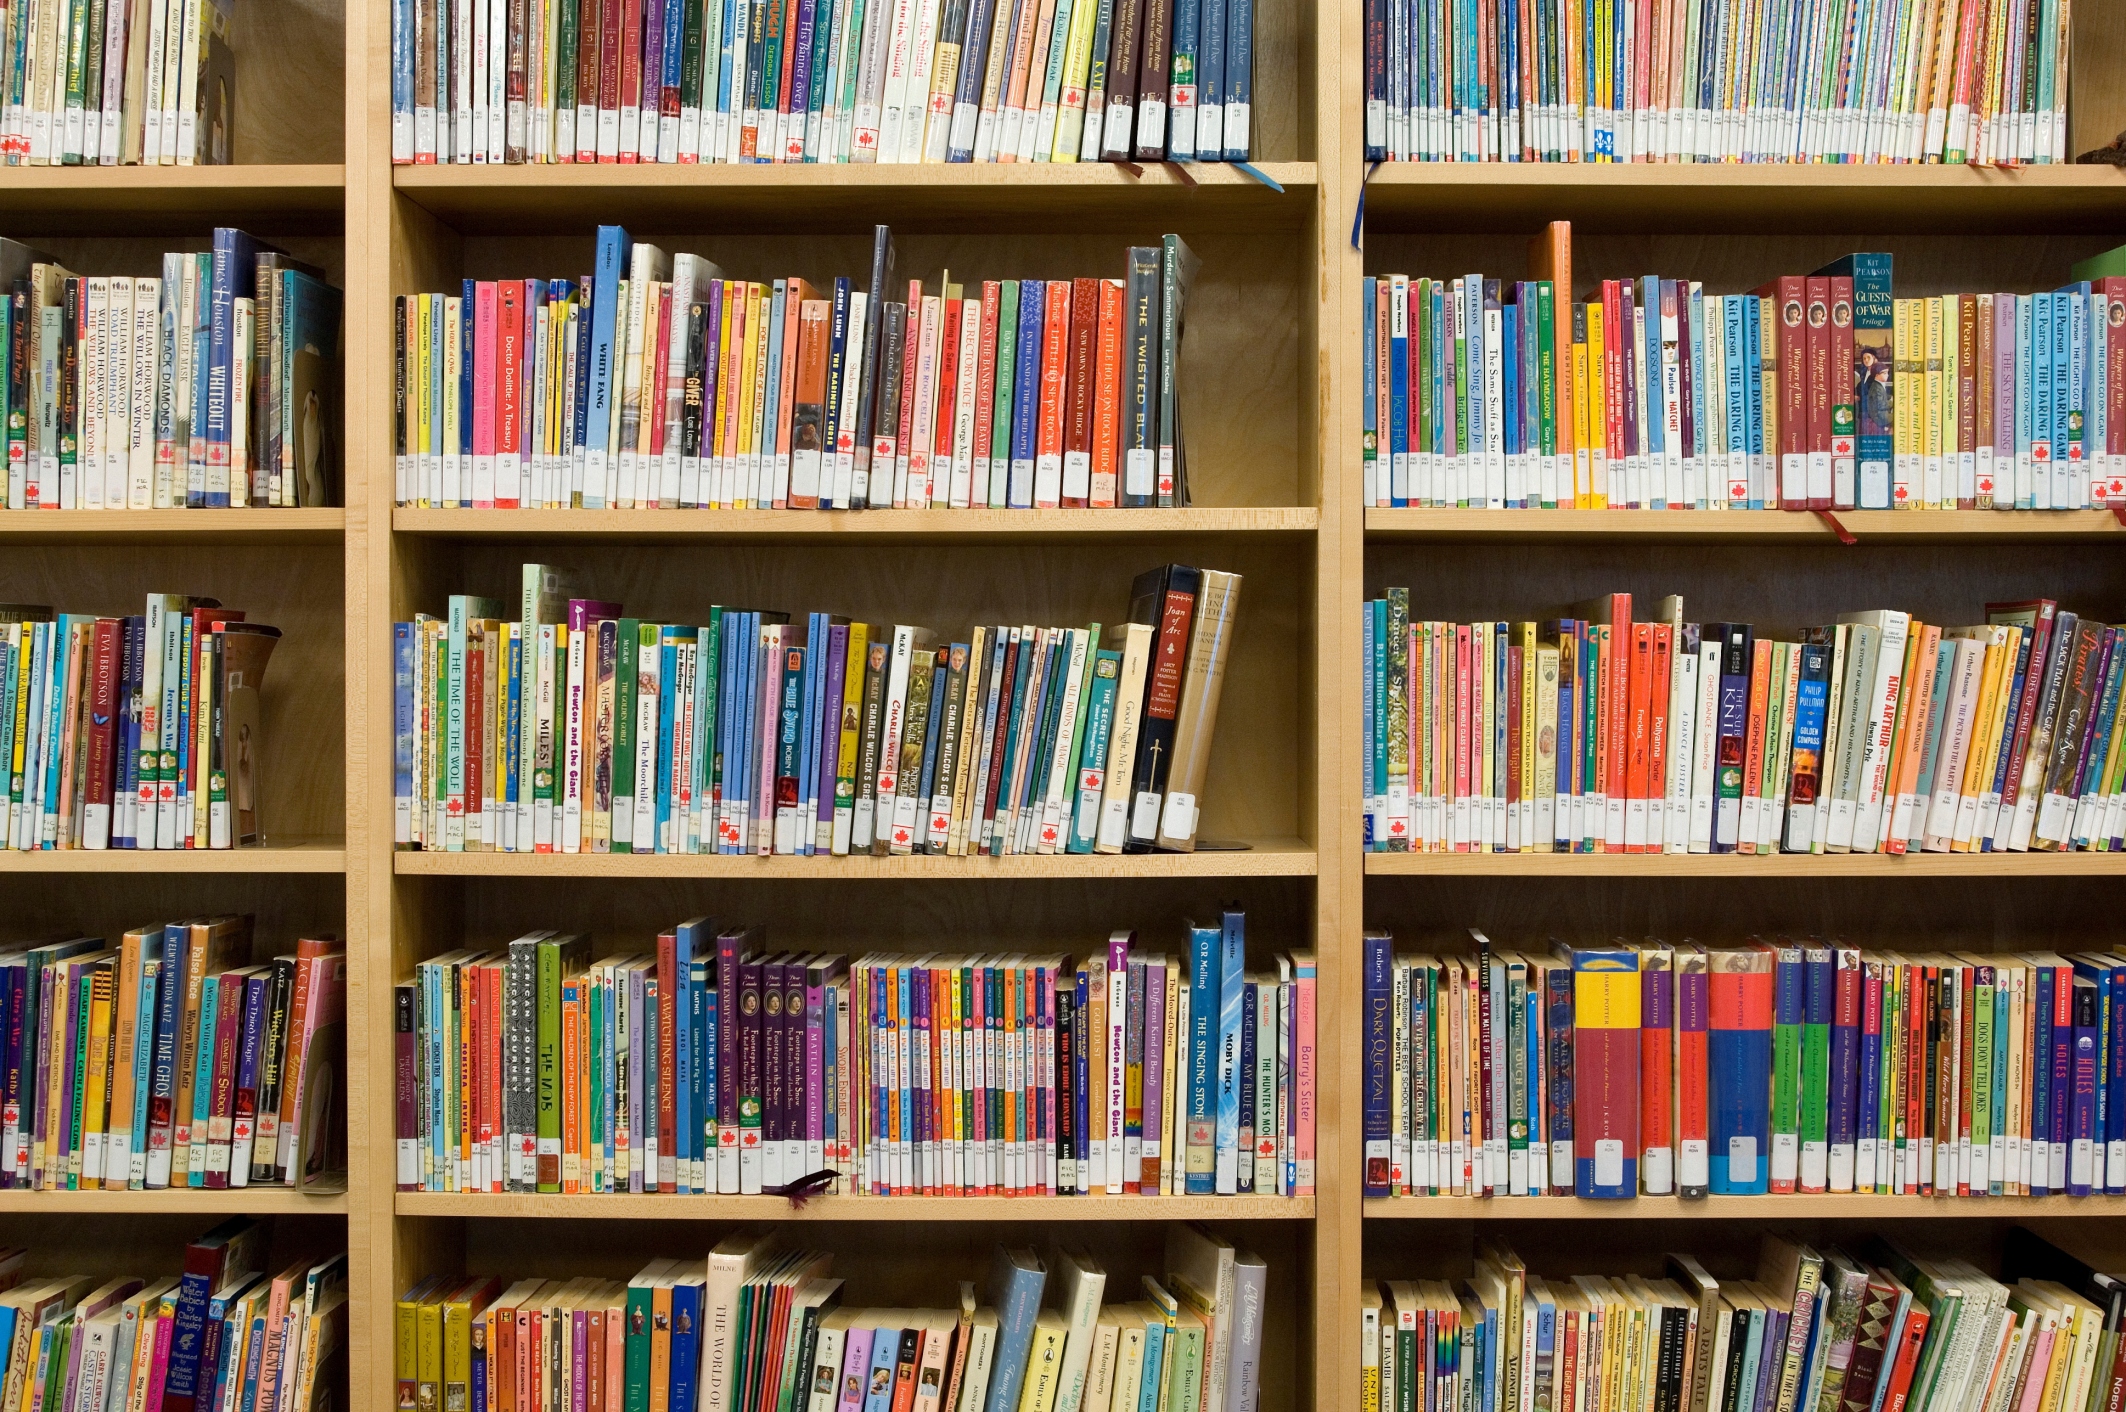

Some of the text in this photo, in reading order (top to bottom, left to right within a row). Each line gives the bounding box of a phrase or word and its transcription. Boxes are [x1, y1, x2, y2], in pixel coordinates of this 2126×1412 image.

[737, 3, 746, 38] WANDER
[816, 21, 827, 45] Spring
[1049, 64, 1059, 81] FAR
[1052, 40, 1063, 63] FROM
[812, 85, 822, 108] March
[1166, 246, 1174, 275] Murder
[836, 288, 844, 310] JOHN
[1165, 286, 1174, 340] Summerhouse
[208, 248, 231, 431] James Houston WHITEOUT
[505, 336, 514, 365] Doctor
[1137, 296, 1148, 404] THE TWISTED
[1472, 335, 1482, 365] Come
[596, 343, 607, 409] WHITE FANG
[1470, 368, 1482, 394] Sing,
[1649, 338, 1659, 386] DOGSONG
[160, 373, 171, 433] DIAMONDS
[505, 368, 514, 401] Dolittle:
[686, 378, 700, 406] GIVER
[830, 372, 838, 416] MARINER'S
[1668, 367, 1678, 432] Paulsen HATCHET
[2002, 352, 2012, 450] THE SKY IS FALLING
[503, 413, 513, 449] Treasury
[826, 420, 835, 445] CURSE
[1470, 397, 1482, 430] Jimmy
[1472, 432, 1482, 444] Jo
[1166, 606, 1185, 616] Joan
[1166, 626, 1181, 635] Arc
[97, 634, 110, 705] EVA IBBOTSON
[2072, 629, 2100, 696] Pirates!
[451, 649, 461, 789] THE TIME OF THE WOLF
[1123, 700, 1134, 725] Good
[1376, 671, 1384, 738] Billion-Dollar
[1702, 674, 1714, 770] GHOST DANCE Susan Price
[1879, 675, 1899, 747] KING ARTHUR
[570, 685, 580, 798] Newton and the Giant
[1057, 683, 1078, 771] ALL KINDS OF MAGIC
[1653, 716, 1663, 757] Pollyanna
[1376, 743, 1384, 759] Bet
[672, 770, 680, 796] NAGANO
[1115, 769, 1127, 786] Tom
[182, 946, 203, 1088] False Face Welwyn Wilton Katz
[1373, 998, 1387, 1035] DARK
[266, 1010, 282, 1085] Witchery Hill
[662, 992, 671, 1112] A WATCHING SILENCE
[1195, 1016, 1206, 1120] THE SINGING STONE
[1224, 1033, 1233, 1095] MOBY DICK
[1976, 1022, 1988, 1112] DOGS DON'T TELL JOKES
[541, 1044, 552, 1111] THE MOB
[1299, 1046, 1312, 1121] Barry's Sister
[1370, 1039, 1385, 1104] QUETZAL
[2077, 1058, 2093, 1094] HOLES
[1542, 1313, 1551, 1334] Schur
[1782, 1271, 1813, 1398] THE CRICKET IN TIMES
[10, 1308, 34, 1407] Judith Kerr
[710, 1305, 726, 1409] THE WORLD OF
[1384, 1348, 1392, 1379] BAMBI
[1579, 1330, 1587, 1361] JESSE'S
[1695, 1326, 1711, 1405] A RAT'S TALE
[1097, 1354, 1109, 1395] Montgomery
[1241, 1361, 1252, 1396] Rainbow
